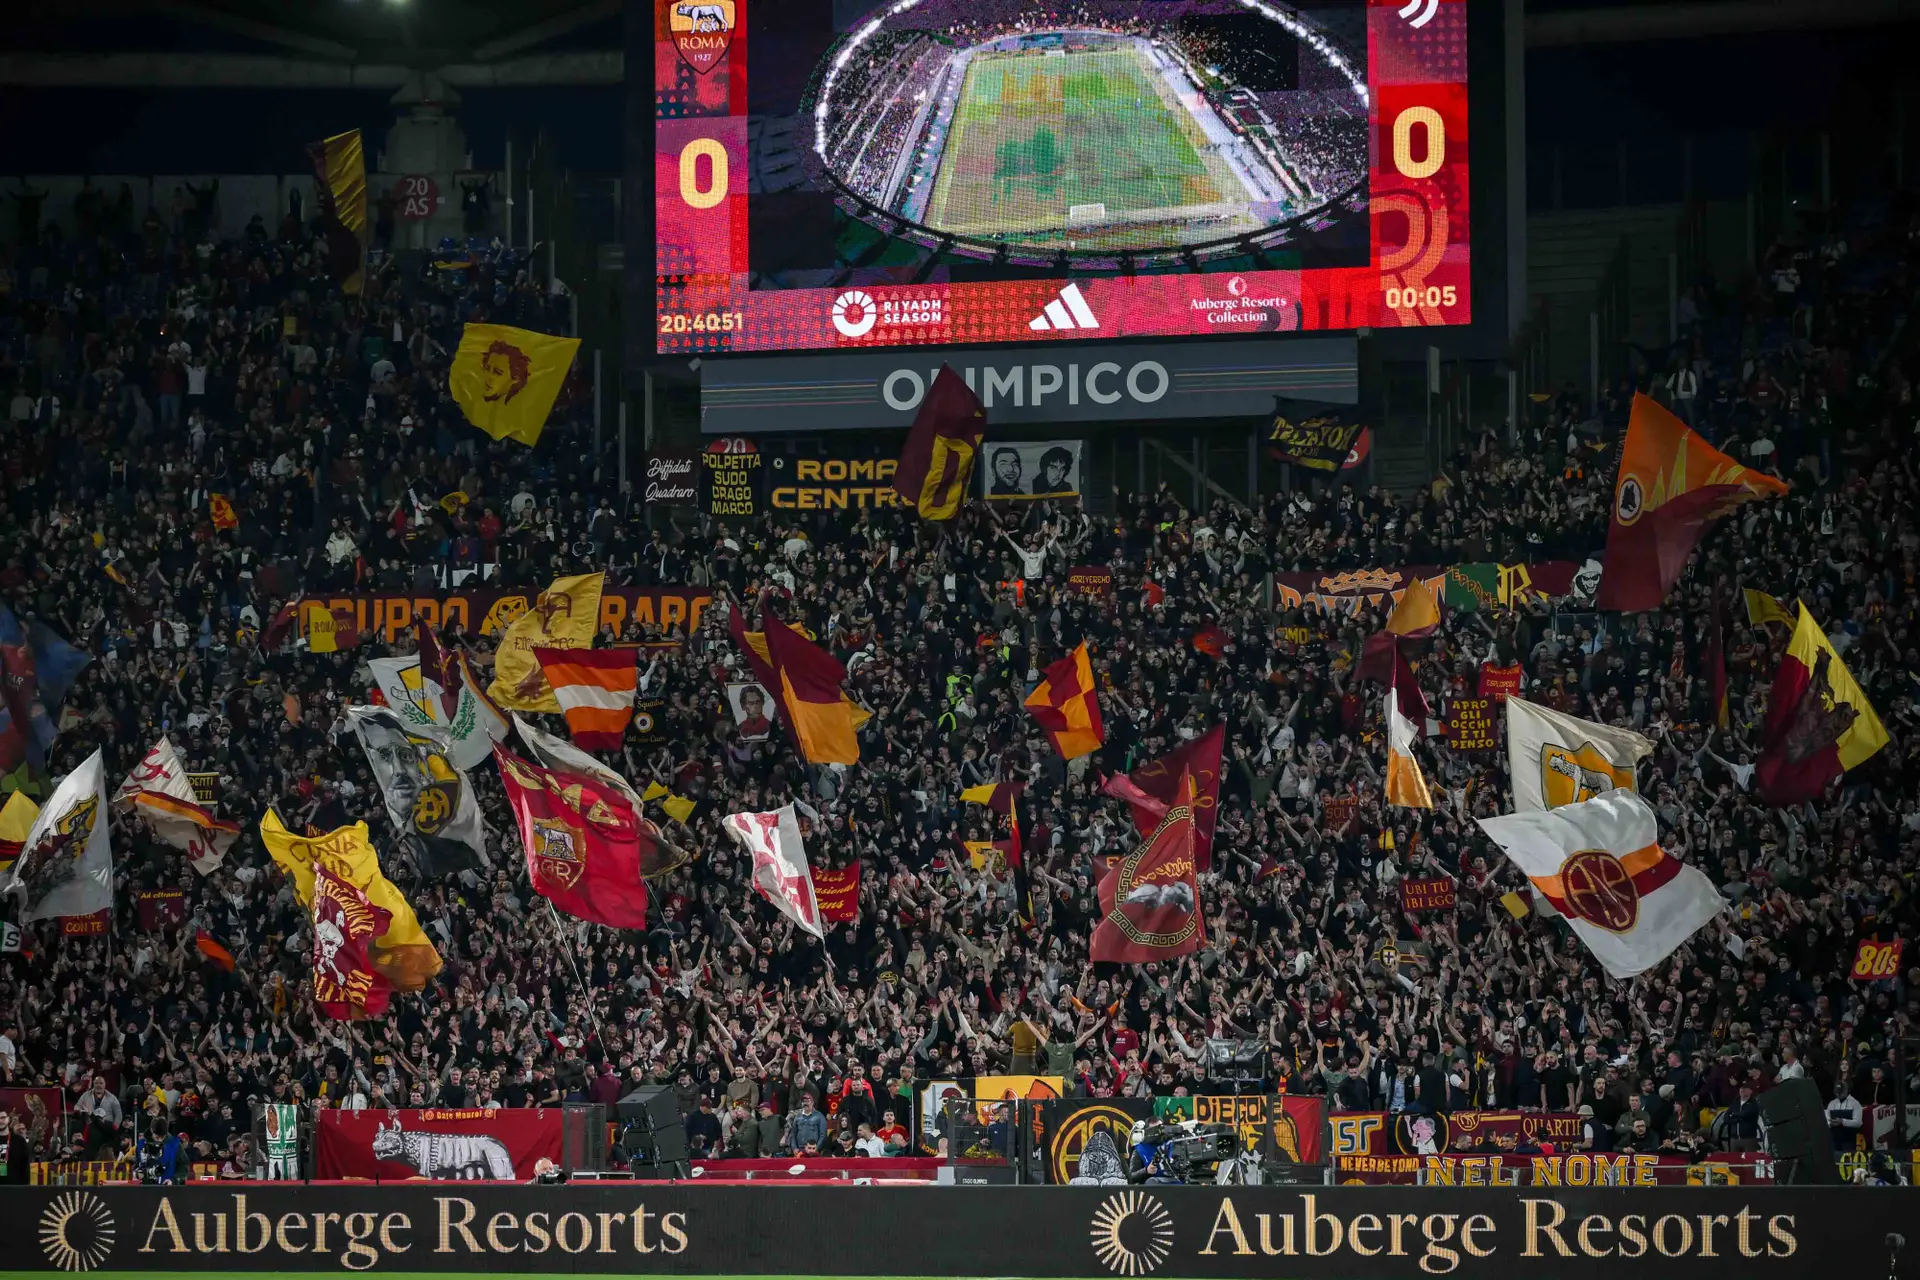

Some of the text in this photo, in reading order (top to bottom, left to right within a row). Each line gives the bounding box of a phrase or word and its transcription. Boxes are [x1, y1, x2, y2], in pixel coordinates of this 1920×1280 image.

[680, 36, 726, 51] ROMA
[693, 53, 712, 62] 1927
[1393, 106, 1445, 178] 0
[679, 138, 729, 209] 0
[406, 177, 428, 196] 20
[404, 196, 430, 216] AS
[883, 299, 942, 312] RIYADH
[1190, 294, 1287, 311] Auberge Resorts
[1385, 286, 1458, 309] 00:05
[660, 312, 744, 333] 20:40:51
[883, 311, 942, 324] SEASON
[1207, 309, 1268, 324] Collection
[702, 453, 762, 469] POLPETTA
[647, 457, 693, 482] Diffidati
[797, 459, 899, 481] ROMA
[714, 470, 748, 486] SUDO
[645, 481, 695, 503] Quadraro
[712, 485, 752, 501] DRAGO
[771, 486, 914, 510] CENTR
[711, 500, 754, 515] MARCO
[1452, 700, 1488, 710] APRO
[1460, 710, 1481, 720] GLI
[1451, 719, 1491, 729] OCCHI
[1460, 729, 1485, 739] E TI
[1451, 739, 1494, 749] PENSO
[1405, 881, 1449, 895] UBI TU
[1406, 898, 1424, 909] IBI
[66, 921, 104, 932] CON TE
[1425, 1154, 1659, 1187] NEL NOME
[137, 1193, 689, 1270] Auberge Resorts
[1198, 1193, 1798, 1274] Auberge Resorts
